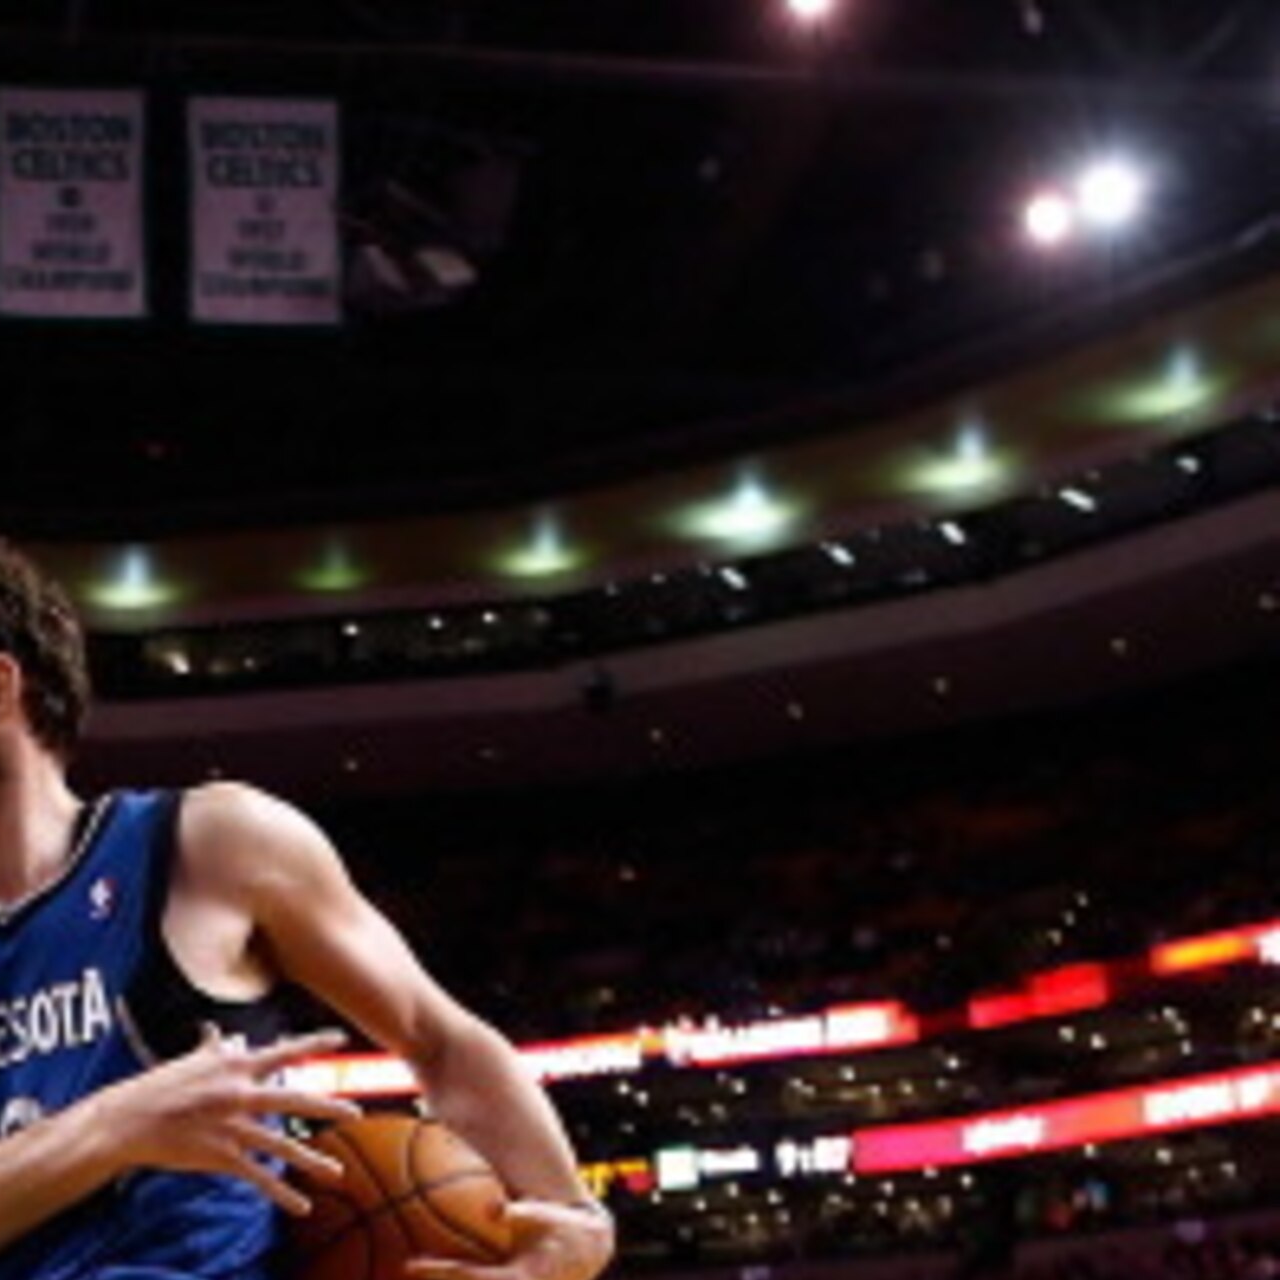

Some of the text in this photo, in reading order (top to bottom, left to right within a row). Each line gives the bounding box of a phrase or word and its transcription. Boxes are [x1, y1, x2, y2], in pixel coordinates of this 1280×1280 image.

[6, 112, 132, 142] BOSTON
[201, 121, 325, 150] BOSTON
[11, 147, 130, 181] CELTICS
[206, 154, 324, 188] CELTICS
